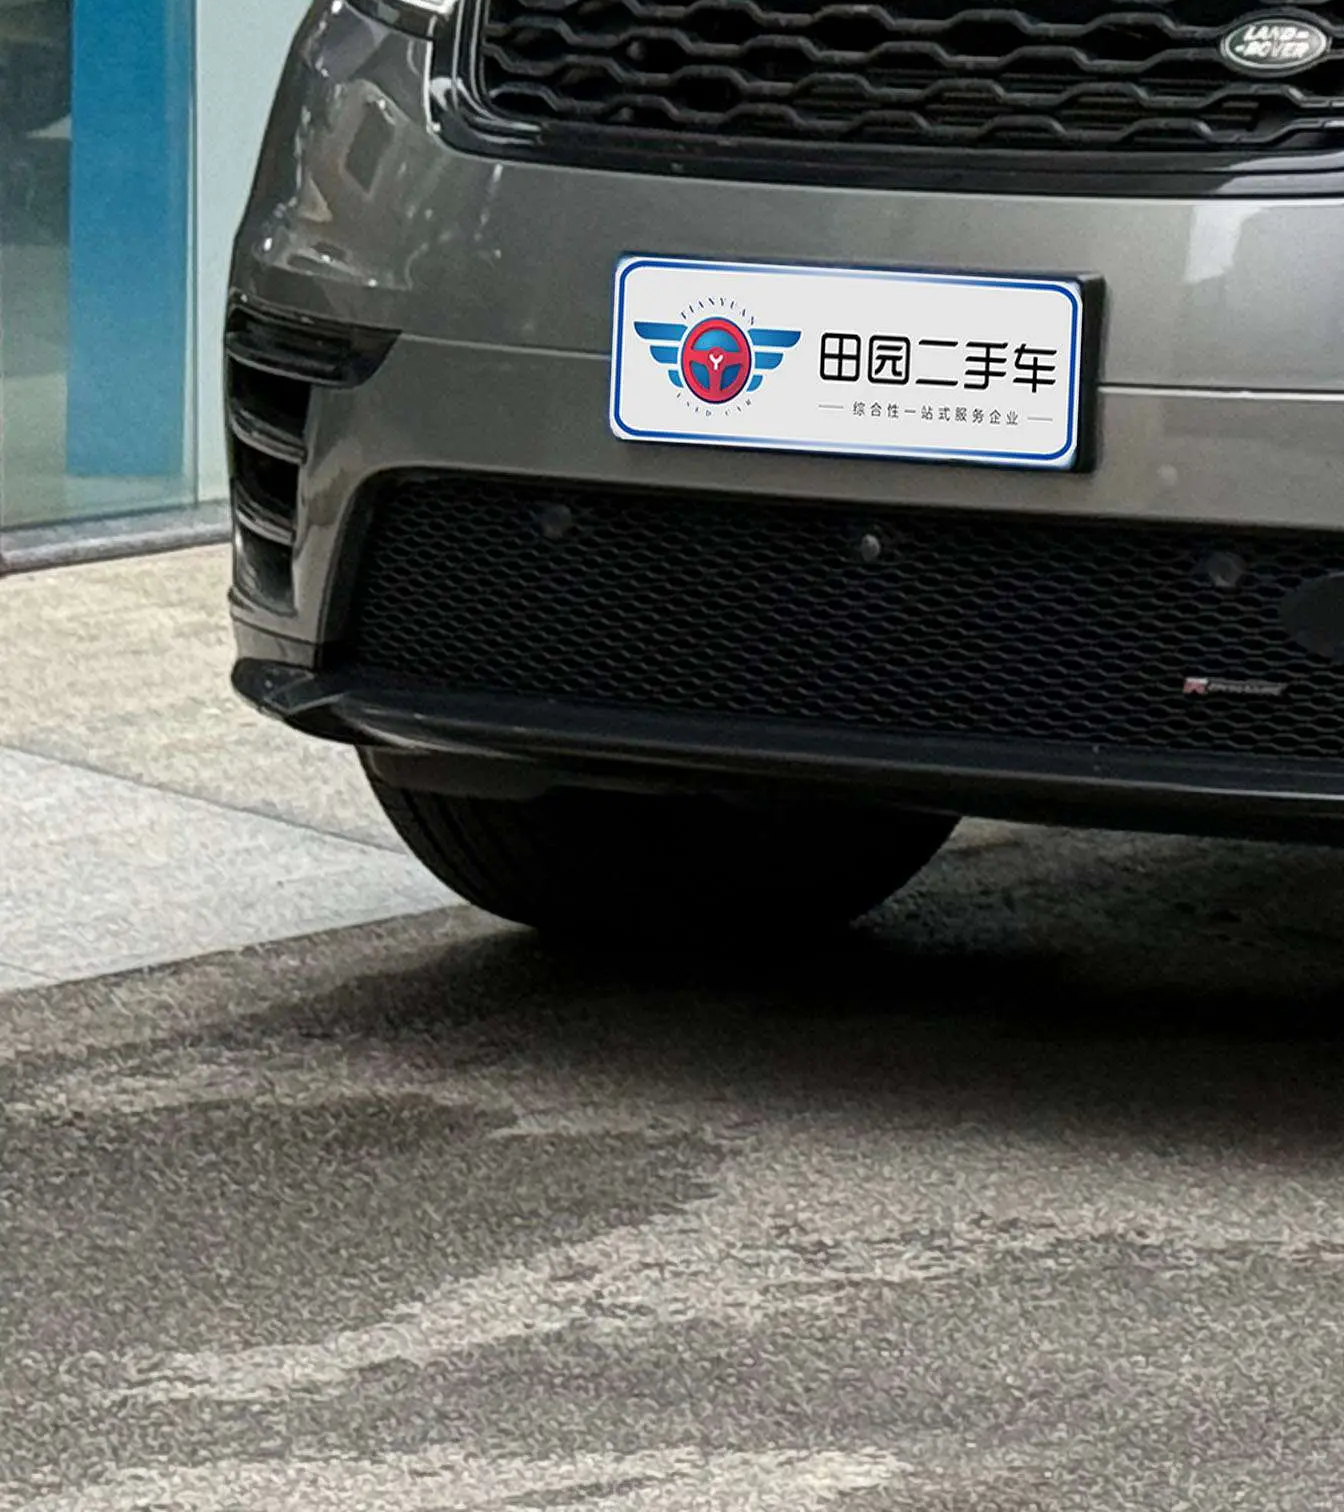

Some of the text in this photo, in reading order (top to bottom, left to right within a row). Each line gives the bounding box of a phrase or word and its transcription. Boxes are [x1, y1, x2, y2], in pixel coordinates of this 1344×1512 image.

[819, 332, 1058, 393] 田园二手车
[851, 400, 1020, 426] 综合性一站式服务企业
